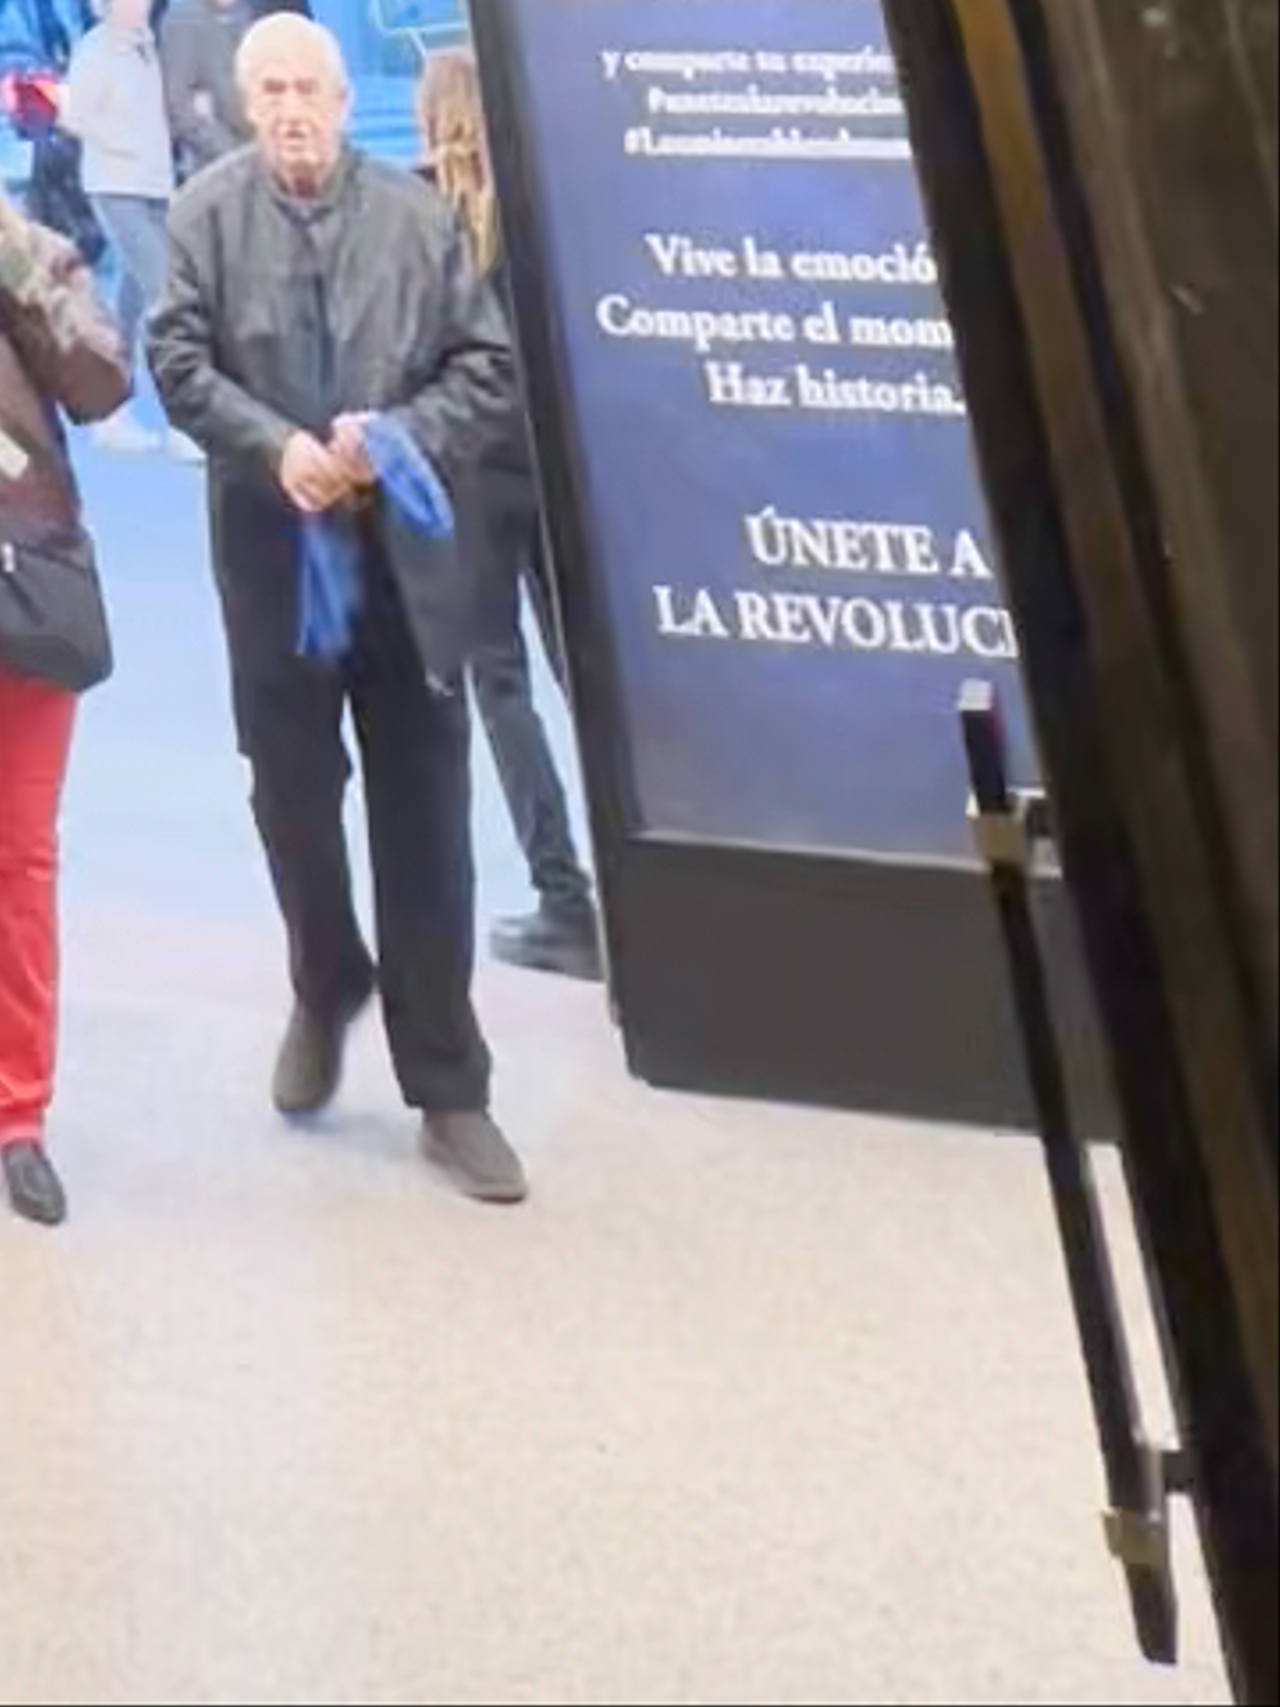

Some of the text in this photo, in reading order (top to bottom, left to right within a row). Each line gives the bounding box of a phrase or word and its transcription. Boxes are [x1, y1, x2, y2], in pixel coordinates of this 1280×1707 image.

[645, 234, 939, 282] Vive la emoció
[595, 294, 955, 353] Comparte el mom
[705, 361, 966, 415] Haz historia.
[745, 505, 993, 578] ÚNETE A
[653, 585, 1019, 658] LA REVOLUCI
